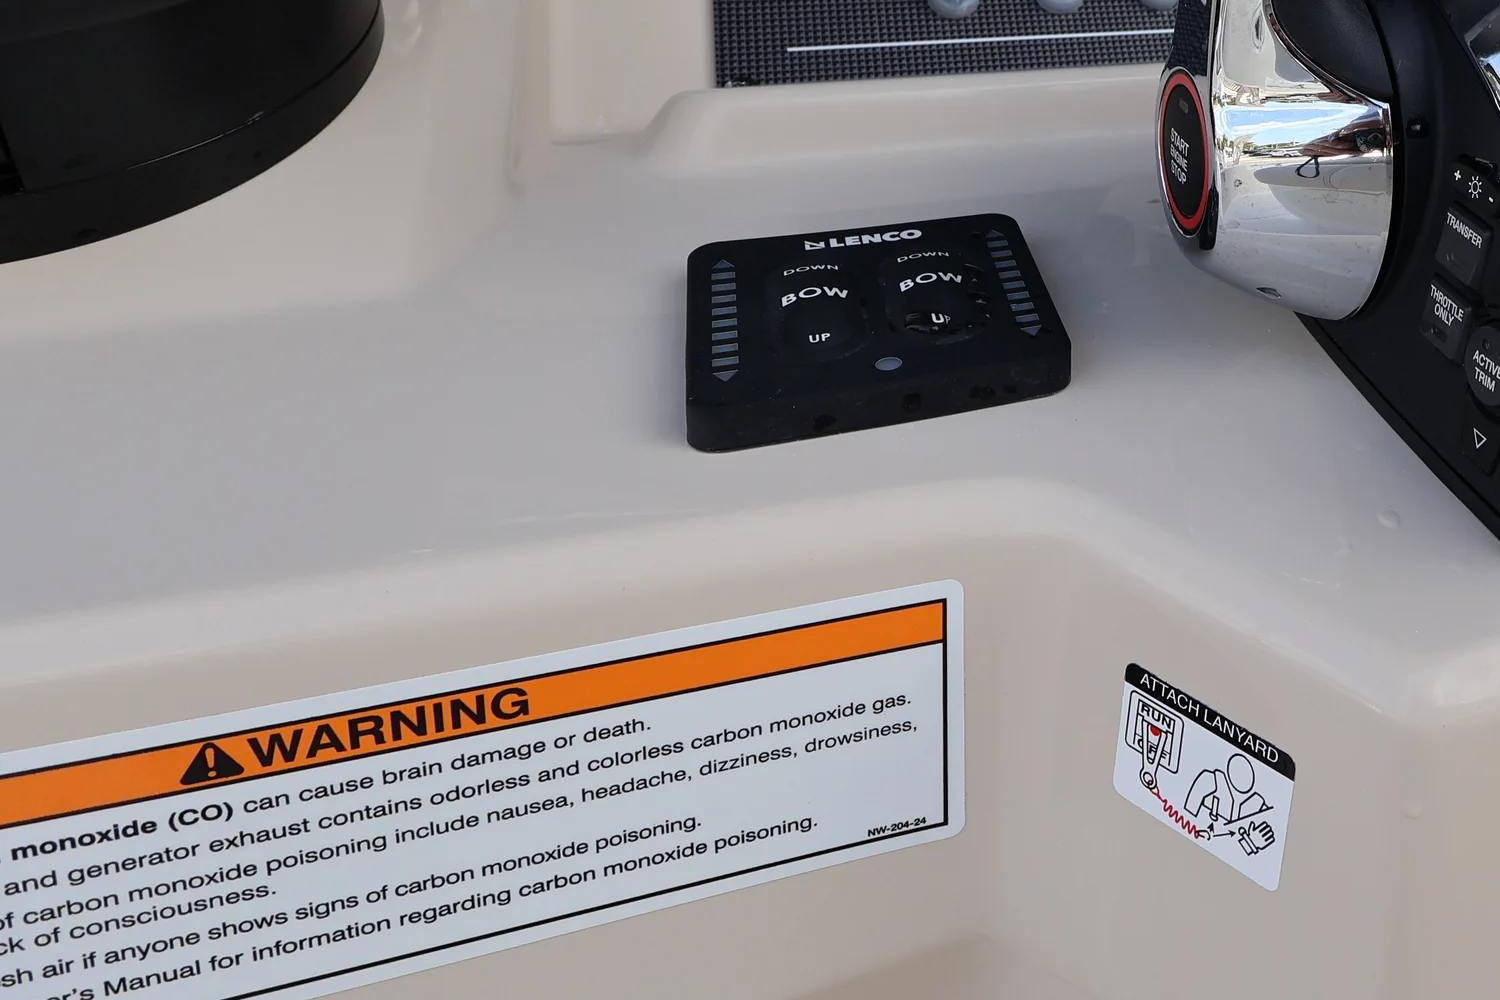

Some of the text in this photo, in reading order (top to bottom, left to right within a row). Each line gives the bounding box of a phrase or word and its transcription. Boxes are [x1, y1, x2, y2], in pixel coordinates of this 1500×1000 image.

[1170, 127, 1190, 157] START
[1170, 143, 1188, 173] ENGINE
[1170, 159, 1187, 185] STOP
[829, 228, 922, 249] LENCO
[1446, 212, 1483, 249] TRANSFER
[783, 264, 839, 277] DOWN
[896, 250, 950, 263] DOWN
[899, 271, 962, 293] BOW
[781, 286, 848, 308] BOW
[1430, 284, 1464, 322] THROTTLE
[931, 312, 952, 326] UP
[1434, 303, 1454, 328] ONLY
[808, 332, 831, 344] UP
[1474, 369, 1496, 393] TRIM
[248, 688, 530, 768] WARNING
[1140, 673, 1279, 764] ATTACH LANYARD
[1141, 703, 1172, 730] RUN
[4, 694, 912, 896] and generator exhaust contains odorless and colorless carbon monoxide gas.
[10, 718, 651, 861] monoxide (CO) can cause brain damage or death.
[22, 893, 120, 925] carbon
[128, 863, 258, 903] monoxide
[266, 835, 387, 877] poisoning
[394, 814, 480, 844] include
[486, 795, 574, 824] nausea,
[581, 769, 692, 803] headache,
[699, 746, 798, 776] dizziness,
[804, 720, 917, 753] drowsiness,
[867, 816, 927, 838] NW-204-24
[0, 816, 702, 988] sh air if anyone shows signs of carbon monoxide poisoning.
[33, 926, 61, 947] of
[69, 885, 276, 940] consciousness.
[103, 959, 202, 997] Manual
[208, 952, 244, 972] for
[251, 918, 391, 962] information
[399, 889, 511, 927] regarding
[518, 869, 596, 898] carbon
[603, 842, 708, 877] monoxide
[714, 817, 818, 854] poisoning.
